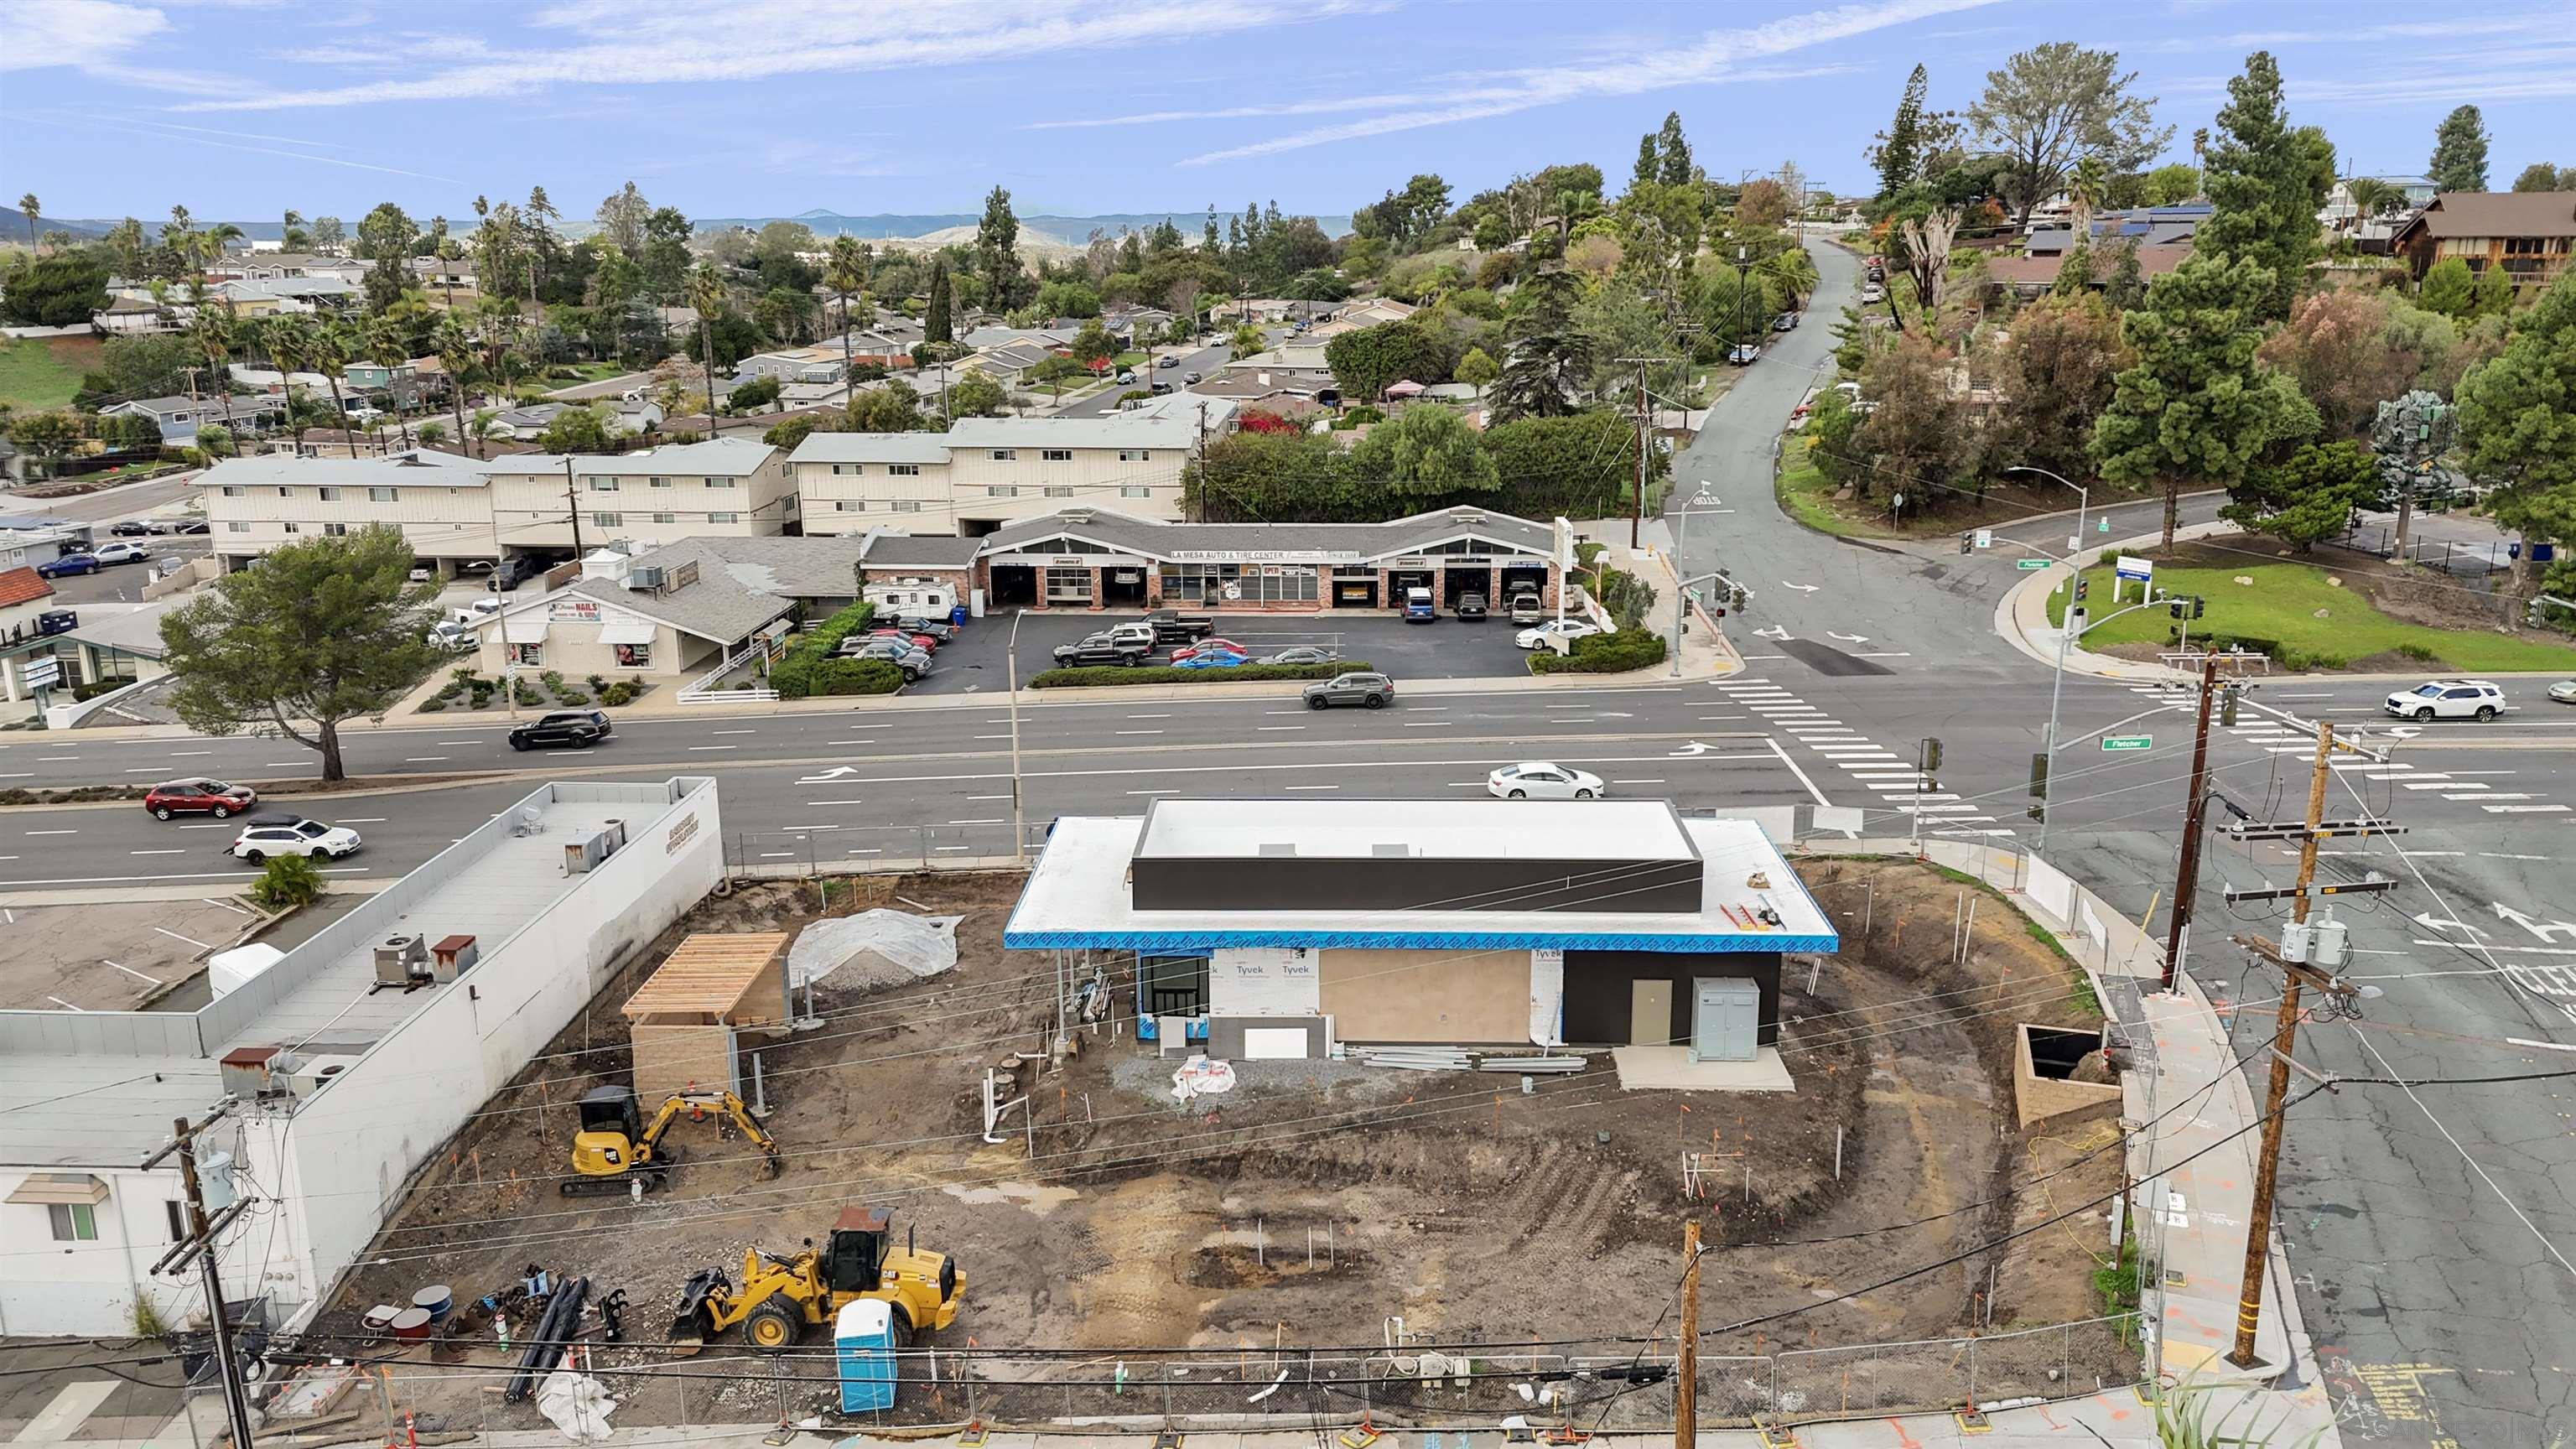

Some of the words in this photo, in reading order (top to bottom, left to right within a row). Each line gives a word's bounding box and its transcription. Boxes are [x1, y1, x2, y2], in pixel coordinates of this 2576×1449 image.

[1693, 496, 1722, 505] STOP
[575, 603, 598, 611] NAILS
[1237, 965, 1264, 975] Tyvek
[1282, 965, 1310, 975] Tyvek
[883, 1270, 896, 1279] CAT
